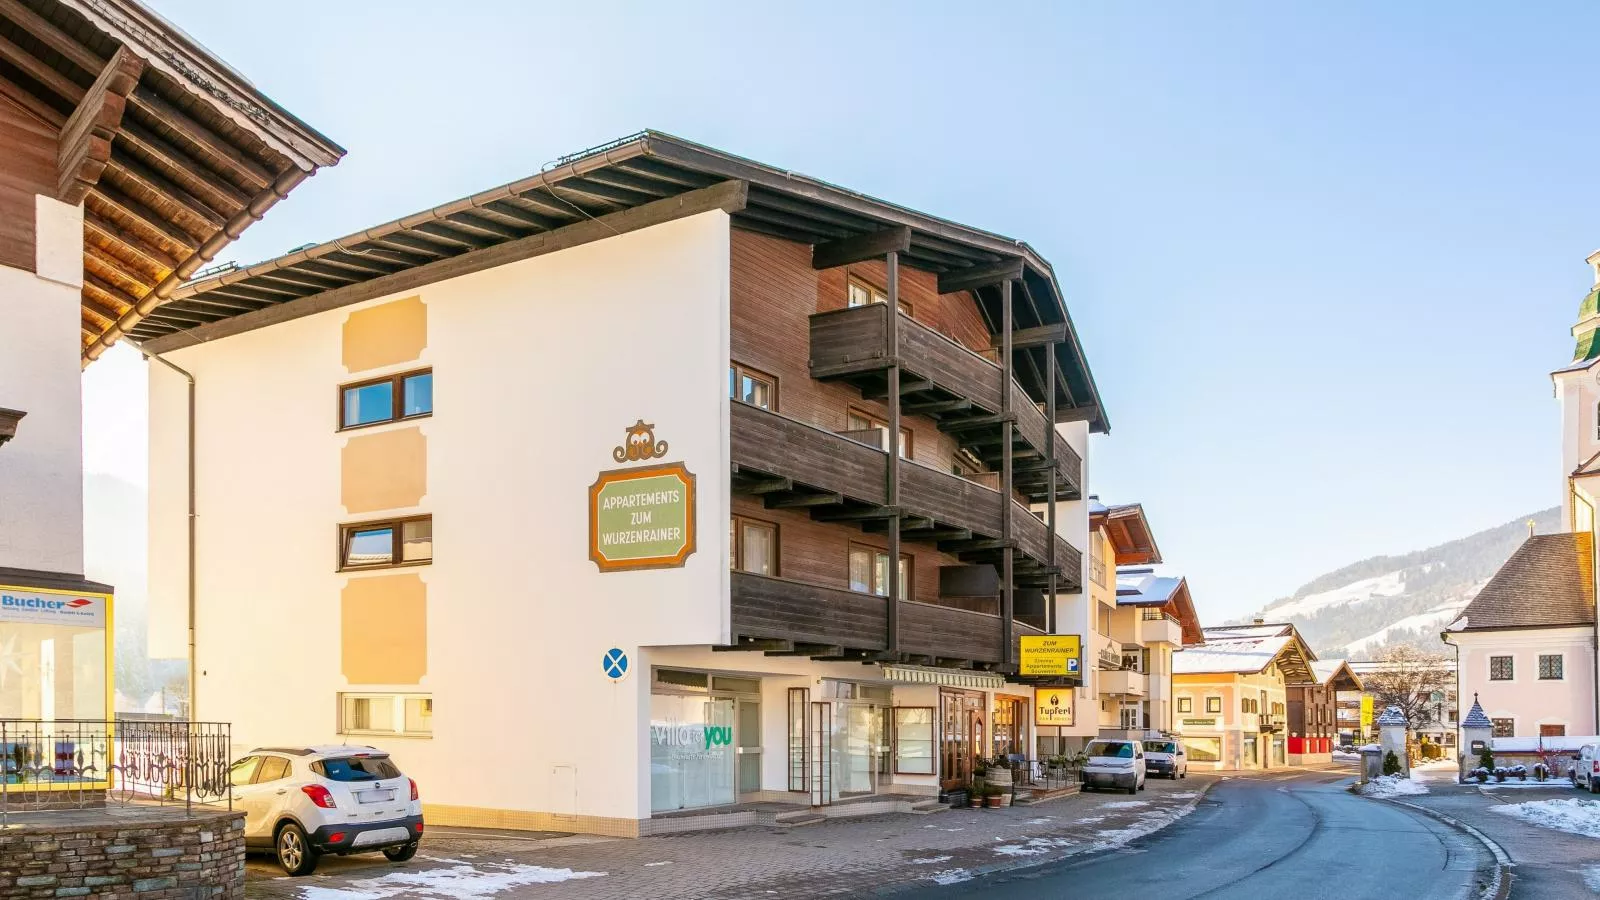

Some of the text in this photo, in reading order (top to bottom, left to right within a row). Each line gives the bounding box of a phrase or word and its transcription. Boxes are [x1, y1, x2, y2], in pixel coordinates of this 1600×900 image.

[603, 490, 680, 510] APPARTEMENTS
[630, 511, 652, 525] ZUM
[602, 527, 680, 545] WURZENRAINER
[1, 595, 65, 609] Bucher
[1039, 706, 1071, 720] Tupferl
